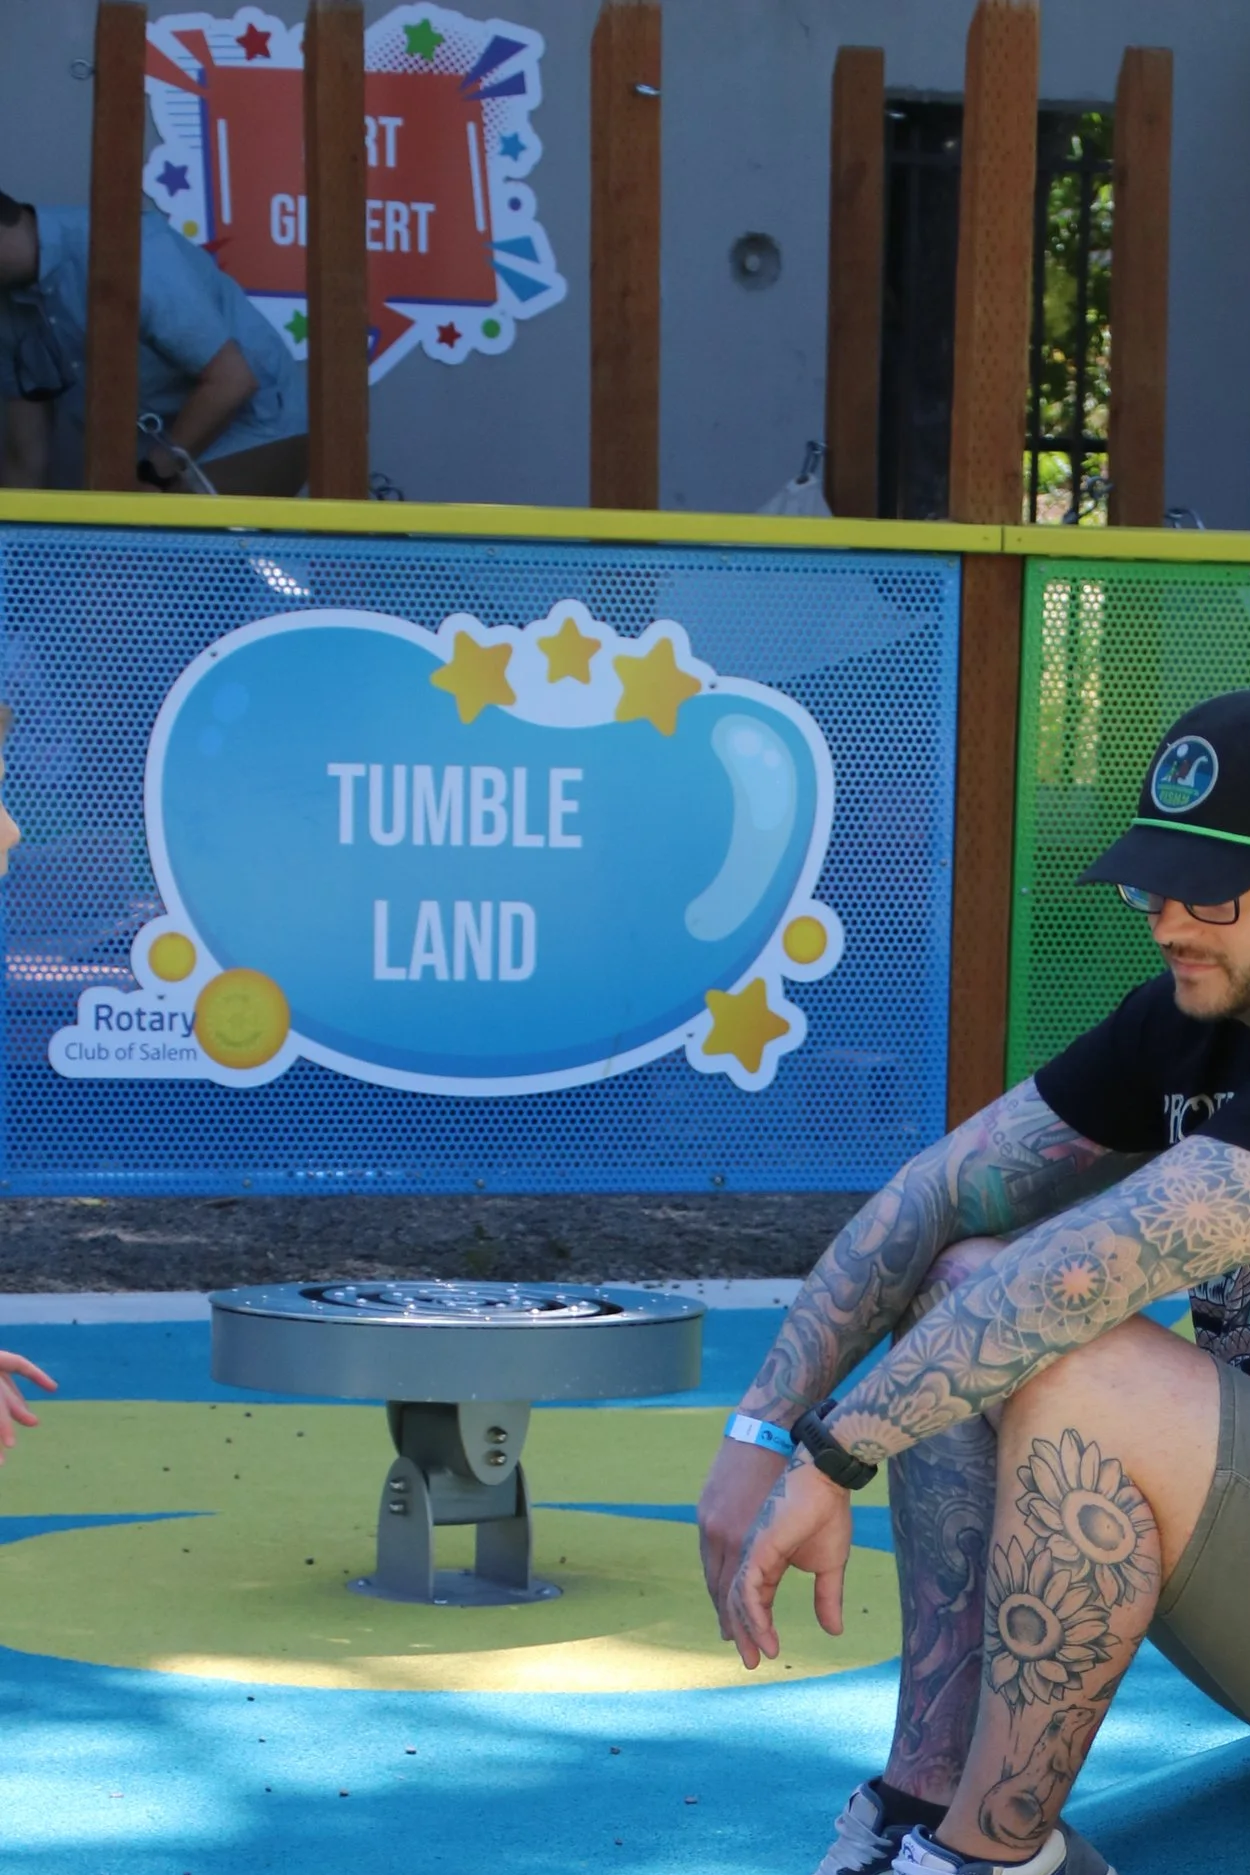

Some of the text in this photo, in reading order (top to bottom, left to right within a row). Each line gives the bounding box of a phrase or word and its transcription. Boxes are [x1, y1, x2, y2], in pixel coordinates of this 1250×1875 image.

[269, 193, 437, 254] GIERT
[327, 763, 583, 848] TUMBLE
[373, 899, 537, 981] LAND
[93, 1003, 197, 1038] Rotary
[64, 1042, 198, 1061] Club of Salem
